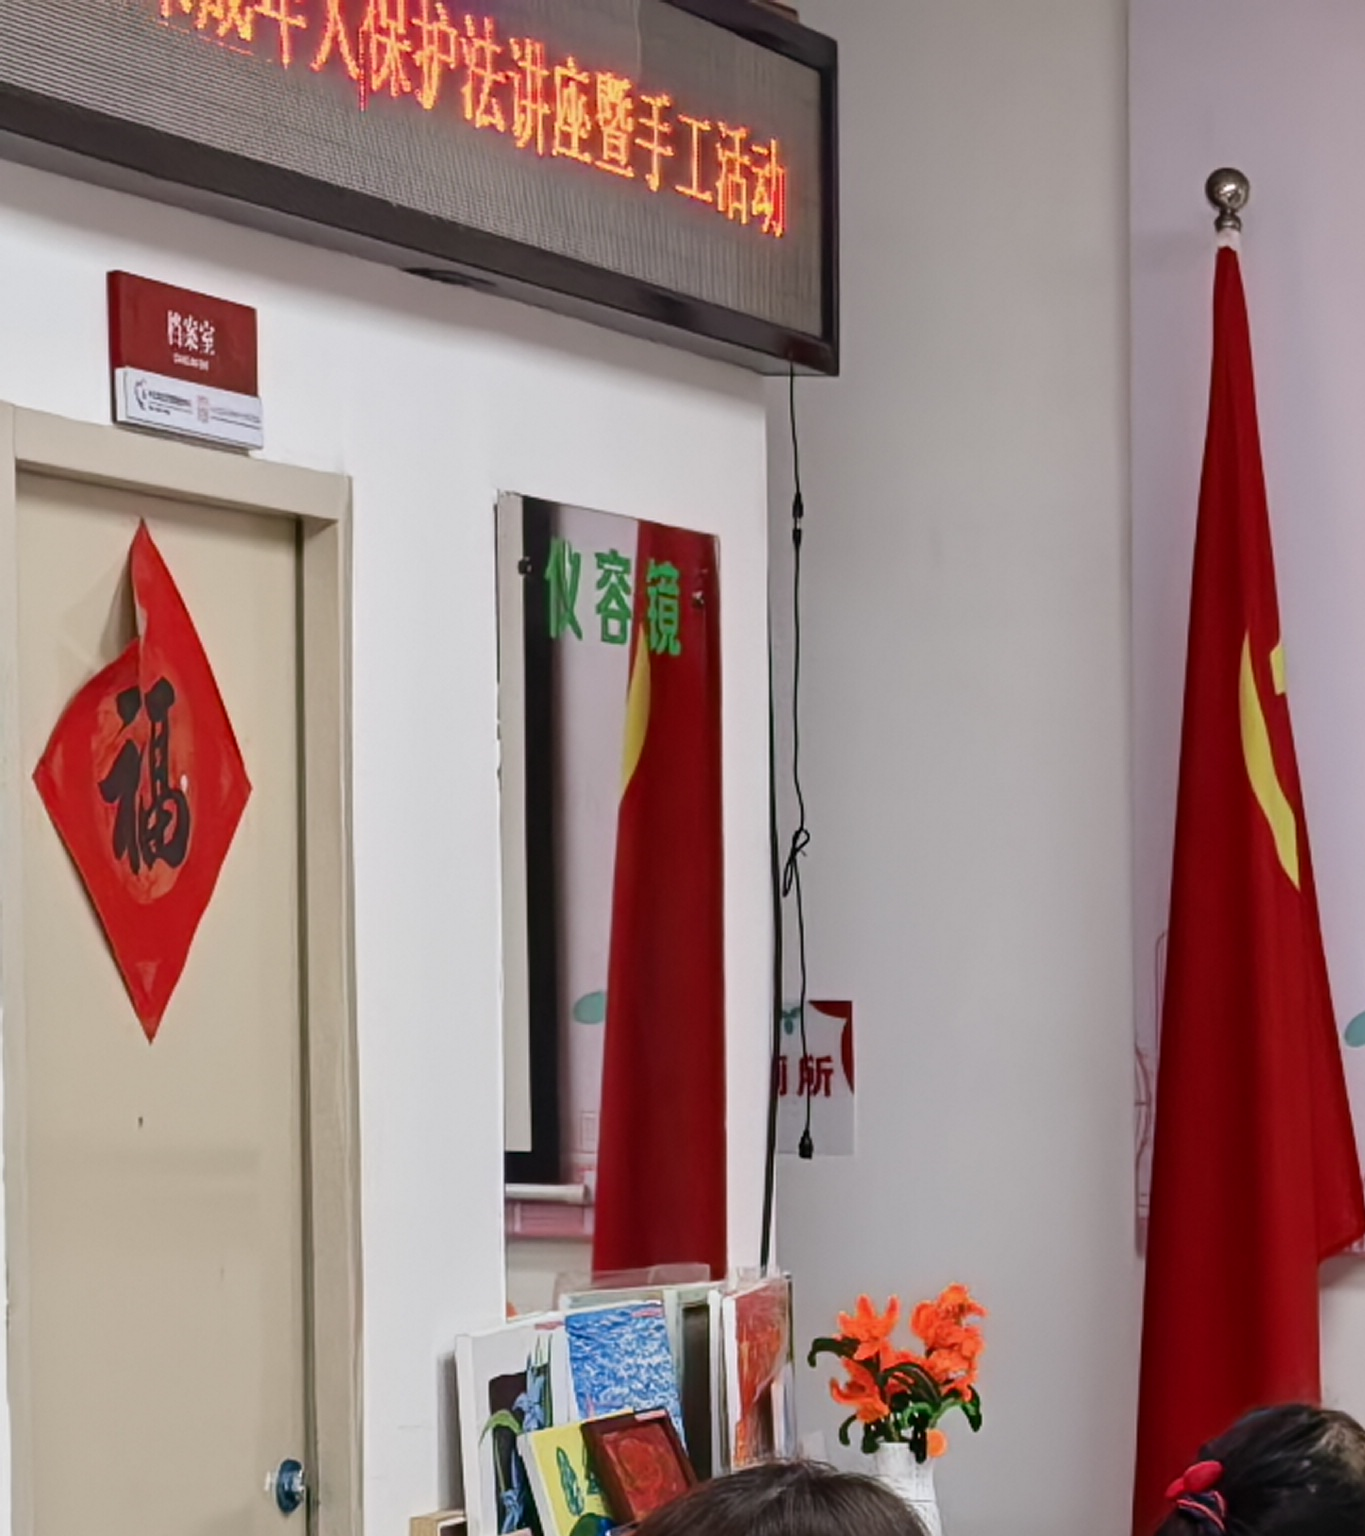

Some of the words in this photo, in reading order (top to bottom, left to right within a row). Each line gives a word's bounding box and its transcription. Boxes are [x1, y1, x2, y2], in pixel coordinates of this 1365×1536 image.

[167, 309, 216, 356] 档案室
[544, 537, 682, 657] 仪容镜
[98, 676, 191, 876] 福
